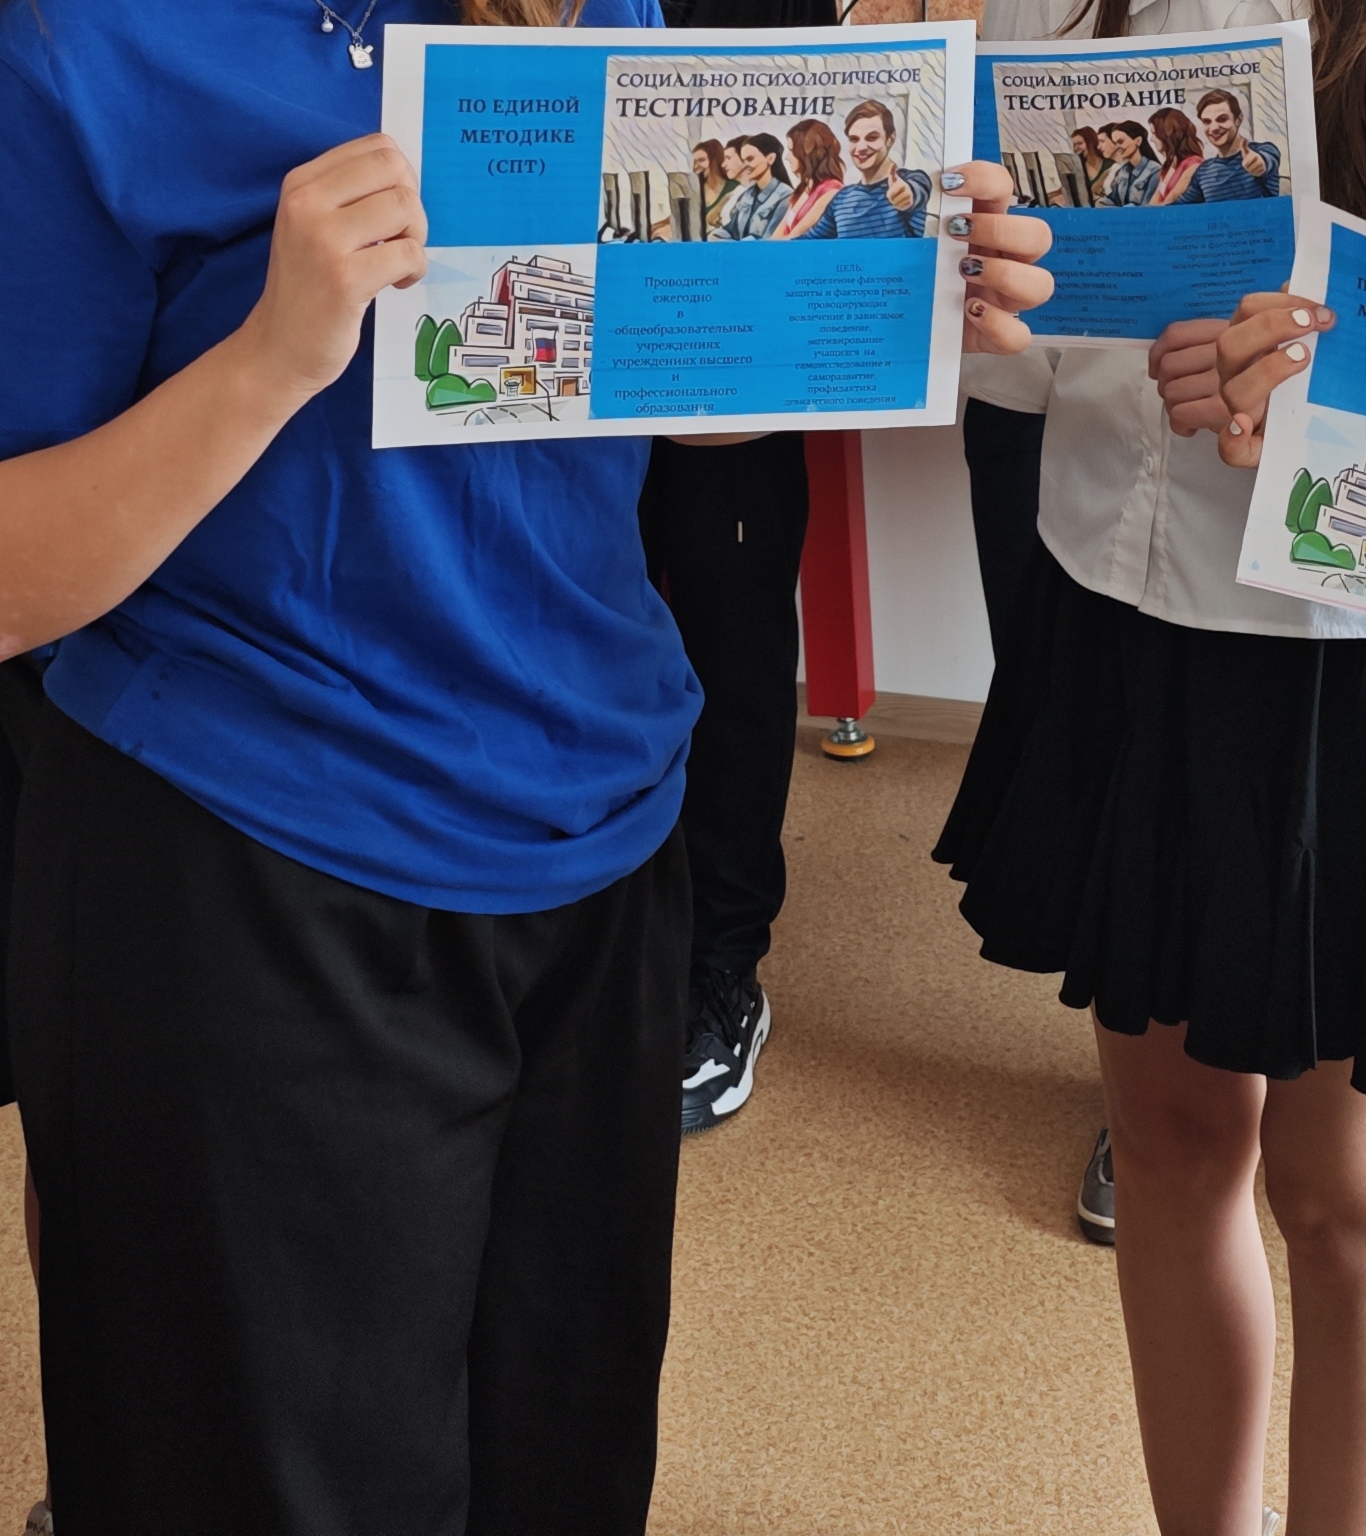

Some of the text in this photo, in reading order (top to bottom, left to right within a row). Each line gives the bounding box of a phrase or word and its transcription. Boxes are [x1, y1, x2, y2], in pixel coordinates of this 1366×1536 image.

[616, 67, 921, 89] СОЦИАЛЬНО ПСИХОЛОГИЧЕСКОЕ
[1001, 62, 1261, 89] СОЦИАЛЬНО ПСИХОЛОГИЧЕСКОЕ
[458, 95, 580, 116] ПО ЕДИНОЙ
[615, 96, 836, 117] ТЕСТИРОВАНИЕ
[1003, 88, 1187, 111] ТЕСТИРОВАНИЕ
[460, 128, 575, 147] МЕТОДИКЕ
[487, 158, 546, 176] (СПТ)
[644, 276, 719, 289] Проводится
[653, 294, 713, 305] ежегодно
[677, 310, 684, 318] в
[636, 341, 721, 353] учреждениях
[612, 356, 696, 369] учреждениях
[699, 354, 753, 366] высшего
[671, 373, 680, 382] и
[614, 387, 738, 401] профессионального
[636, 403, 714, 415] образования
